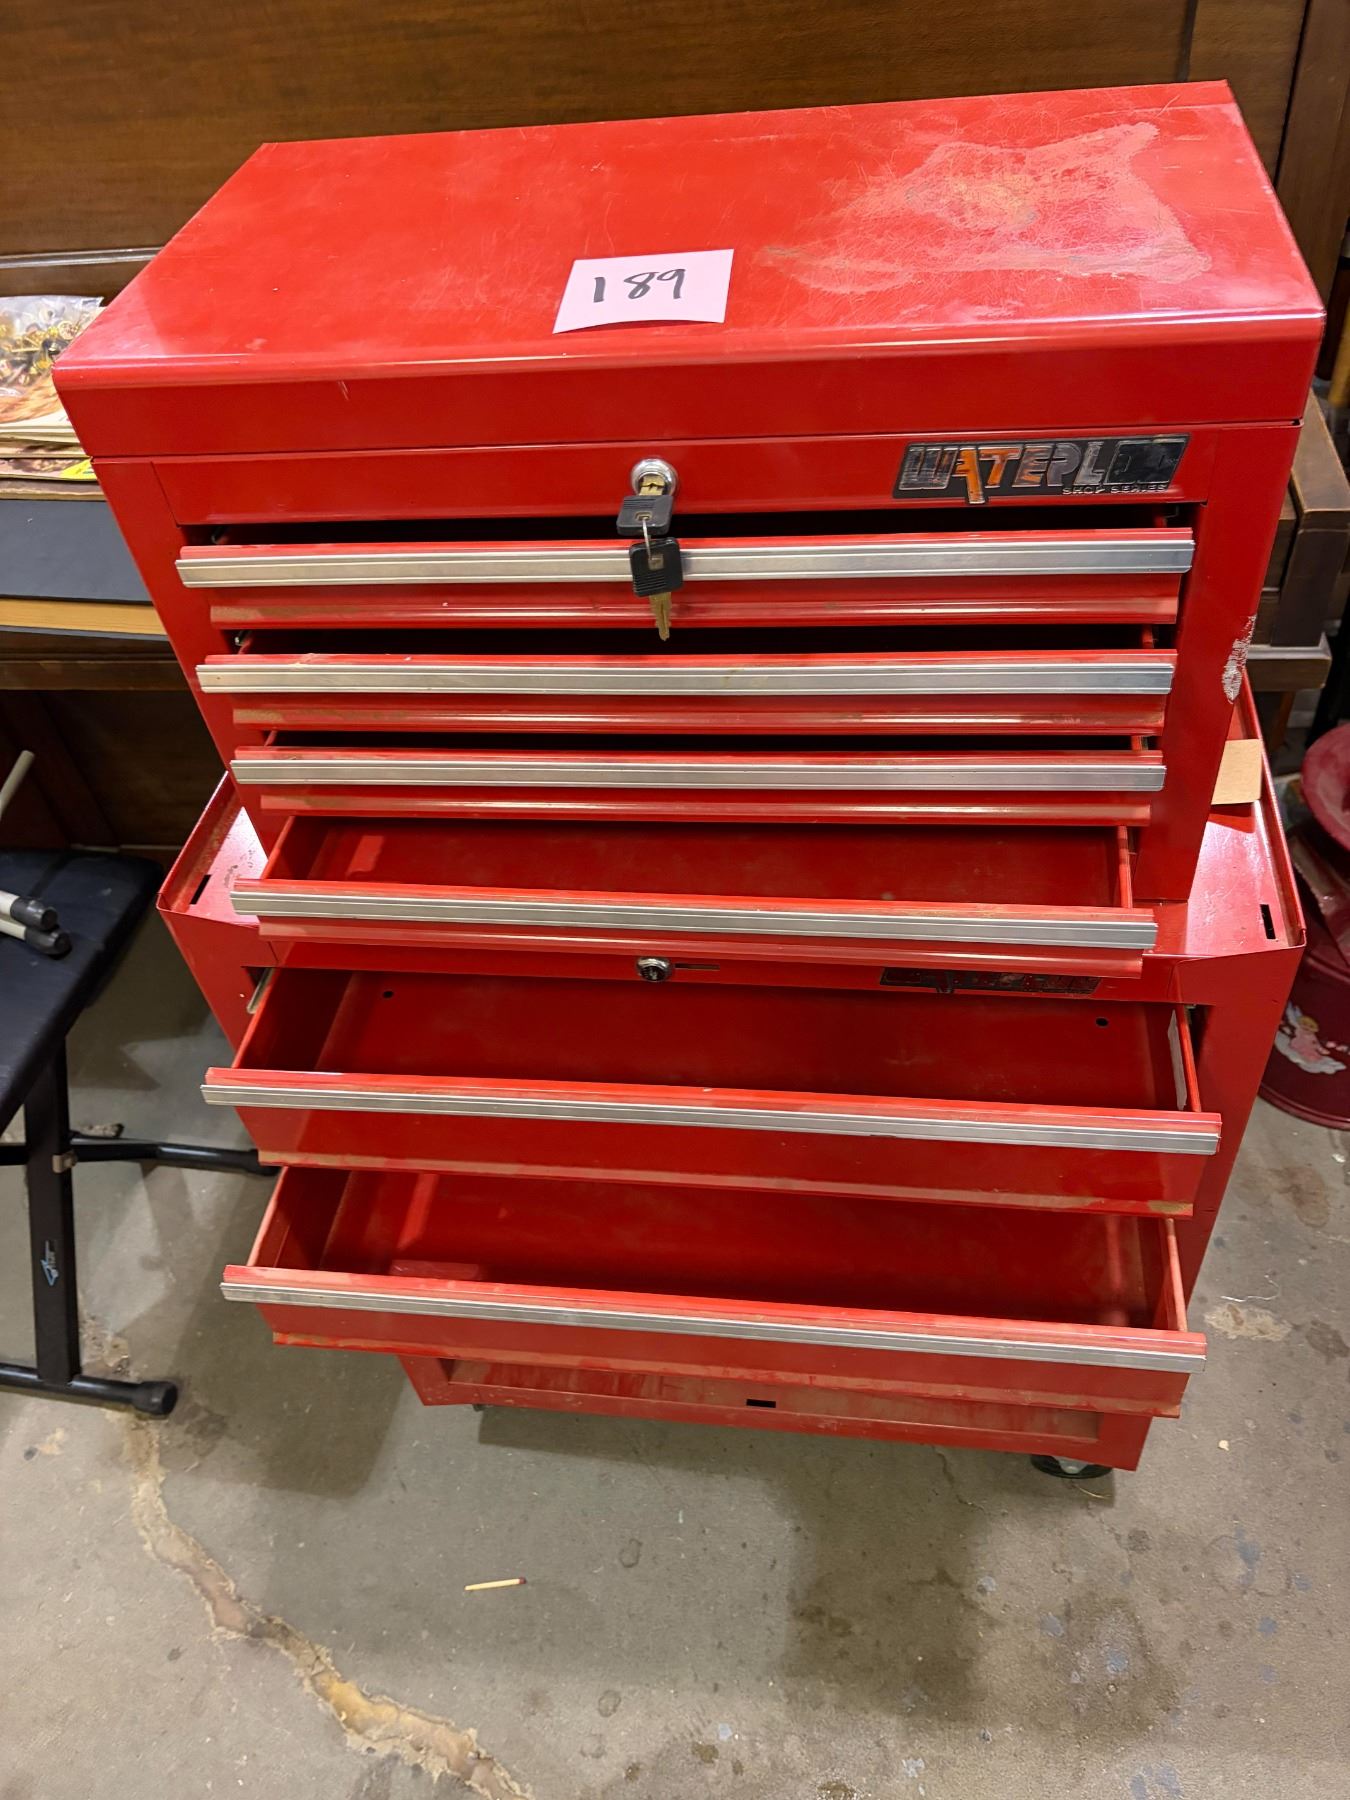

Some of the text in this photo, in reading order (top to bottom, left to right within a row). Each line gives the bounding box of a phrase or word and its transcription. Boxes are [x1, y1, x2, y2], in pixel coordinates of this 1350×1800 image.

[593, 268, 686, 303] 189
[1062, 483, 1168, 495] SHOP SERIES
